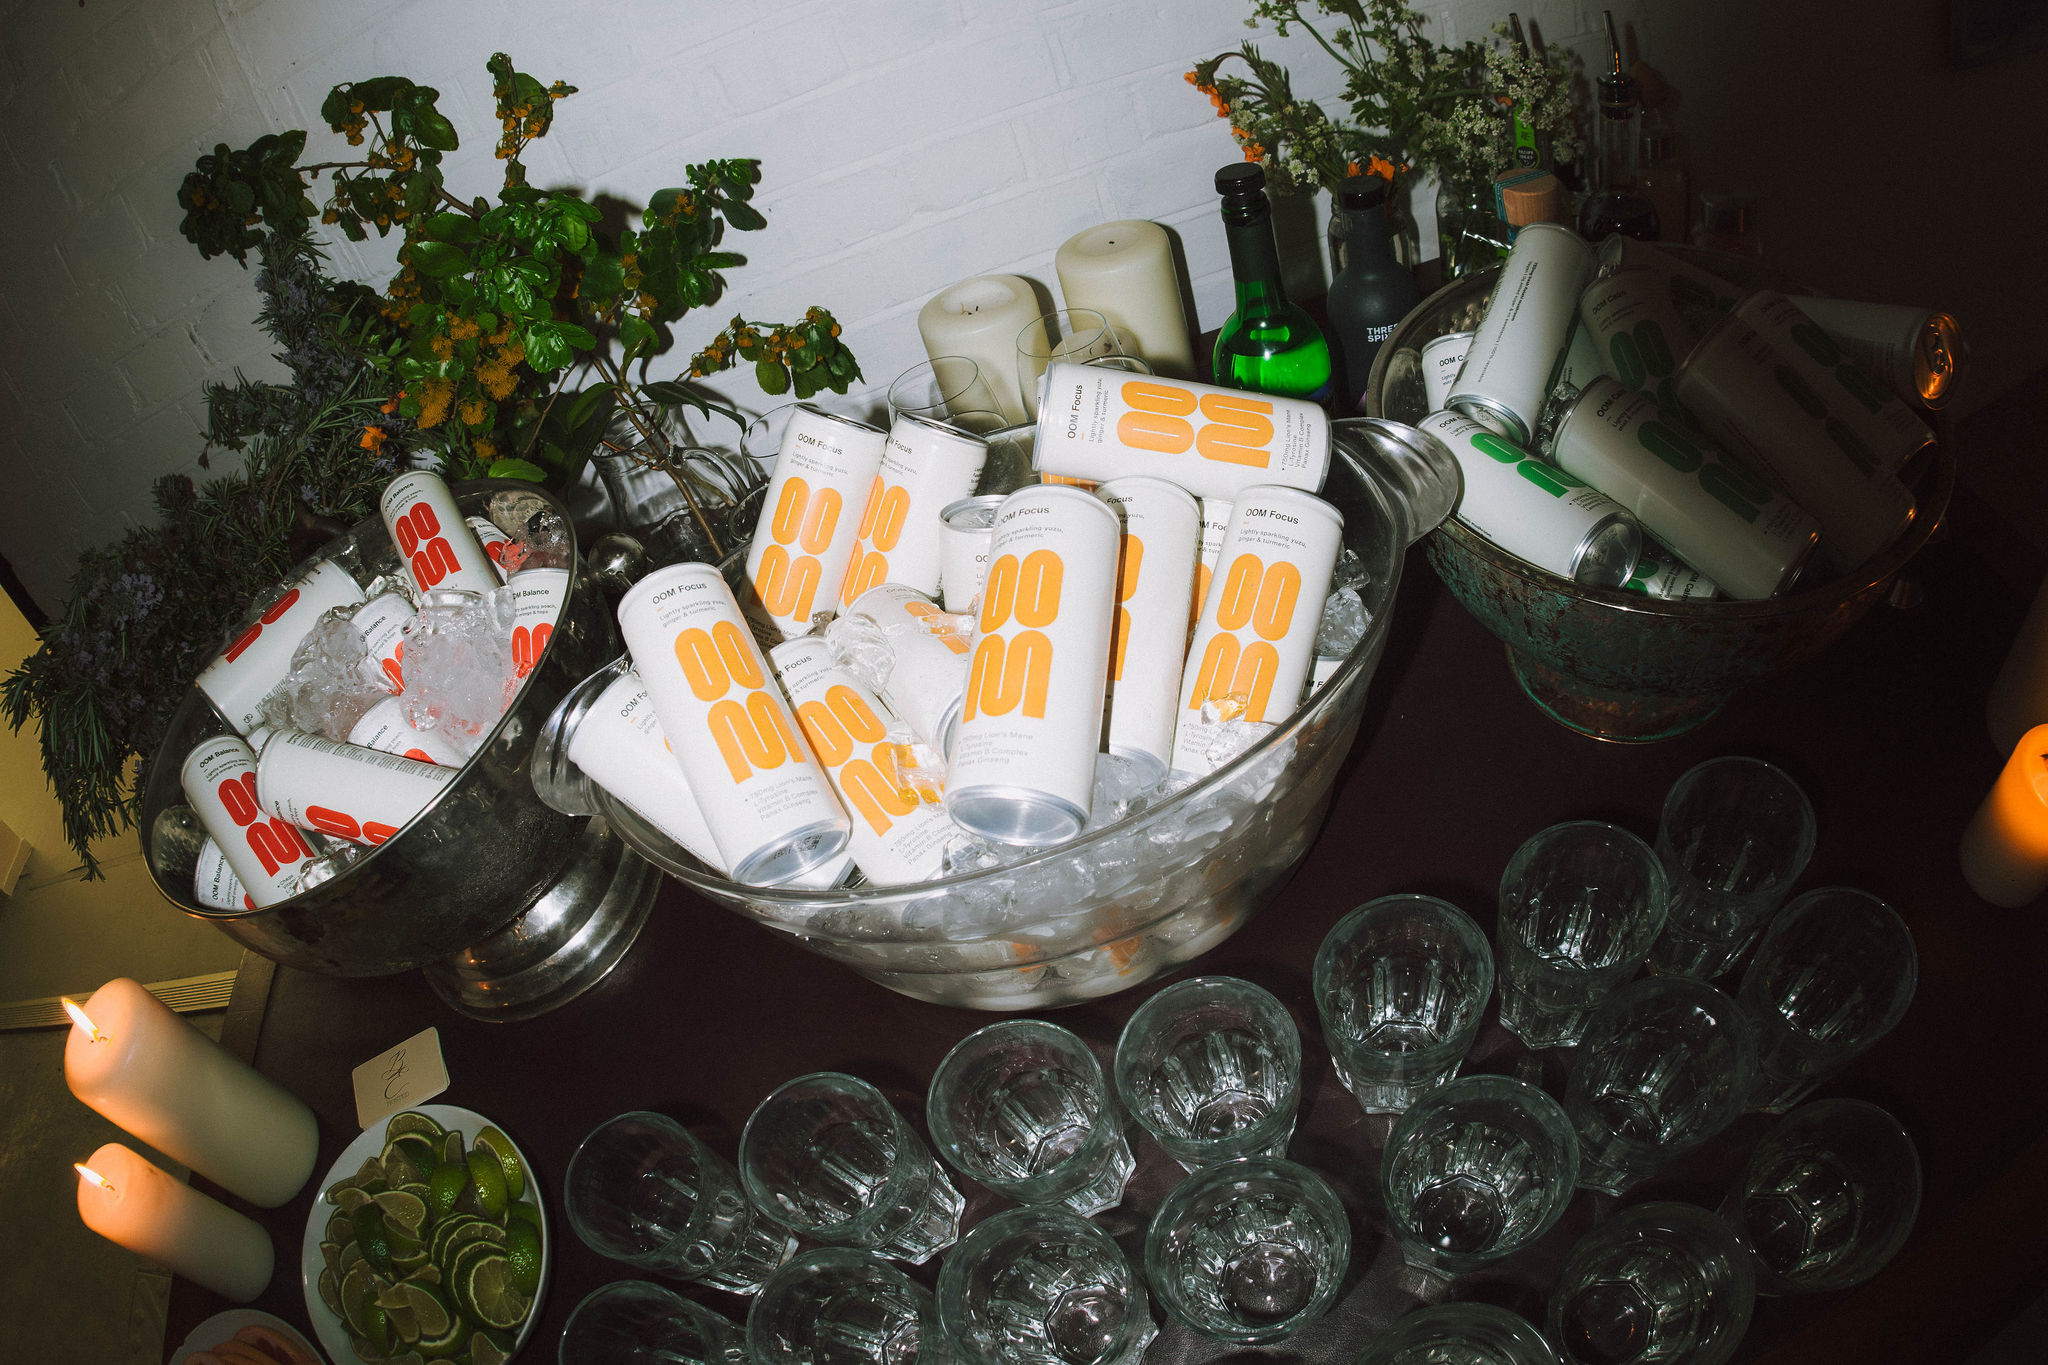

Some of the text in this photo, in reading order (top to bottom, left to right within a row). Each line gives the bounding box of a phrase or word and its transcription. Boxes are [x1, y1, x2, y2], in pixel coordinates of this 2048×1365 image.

[1368, 333, 1388, 343] SPI
[1439, 356, 1456, 366] OOM
[1067, 384, 1083, 439] OOM Focus
[1089, 420, 1099, 443] Lightly
[797, 433, 843, 455] OOM Focus
[895, 440, 913, 455] Focus
[393, 482, 414, 499] Balance
[1106, 495, 1134, 505] Focus
[1018, 507, 1050, 517] Focus
[1245, 508, 1300, 525] OOM Focus
[1240, 528, 1258, 537] Lightly
[1260, 530, 1290, 543] sparkling
[975, 554, 989, 563] OO
[523, 589, 550, 598] Balance
[652, 582, 708, 605] OOM Focus
[364, 616, 387, 637] Balance
[784, 655, 813, 673] Focus
[620, 697, 640, 718] OOM
[366, 724, 389, 749] Balance
[200, 747, 240, 768] OOM Balance
[211, 884, 219, 901] OOM
